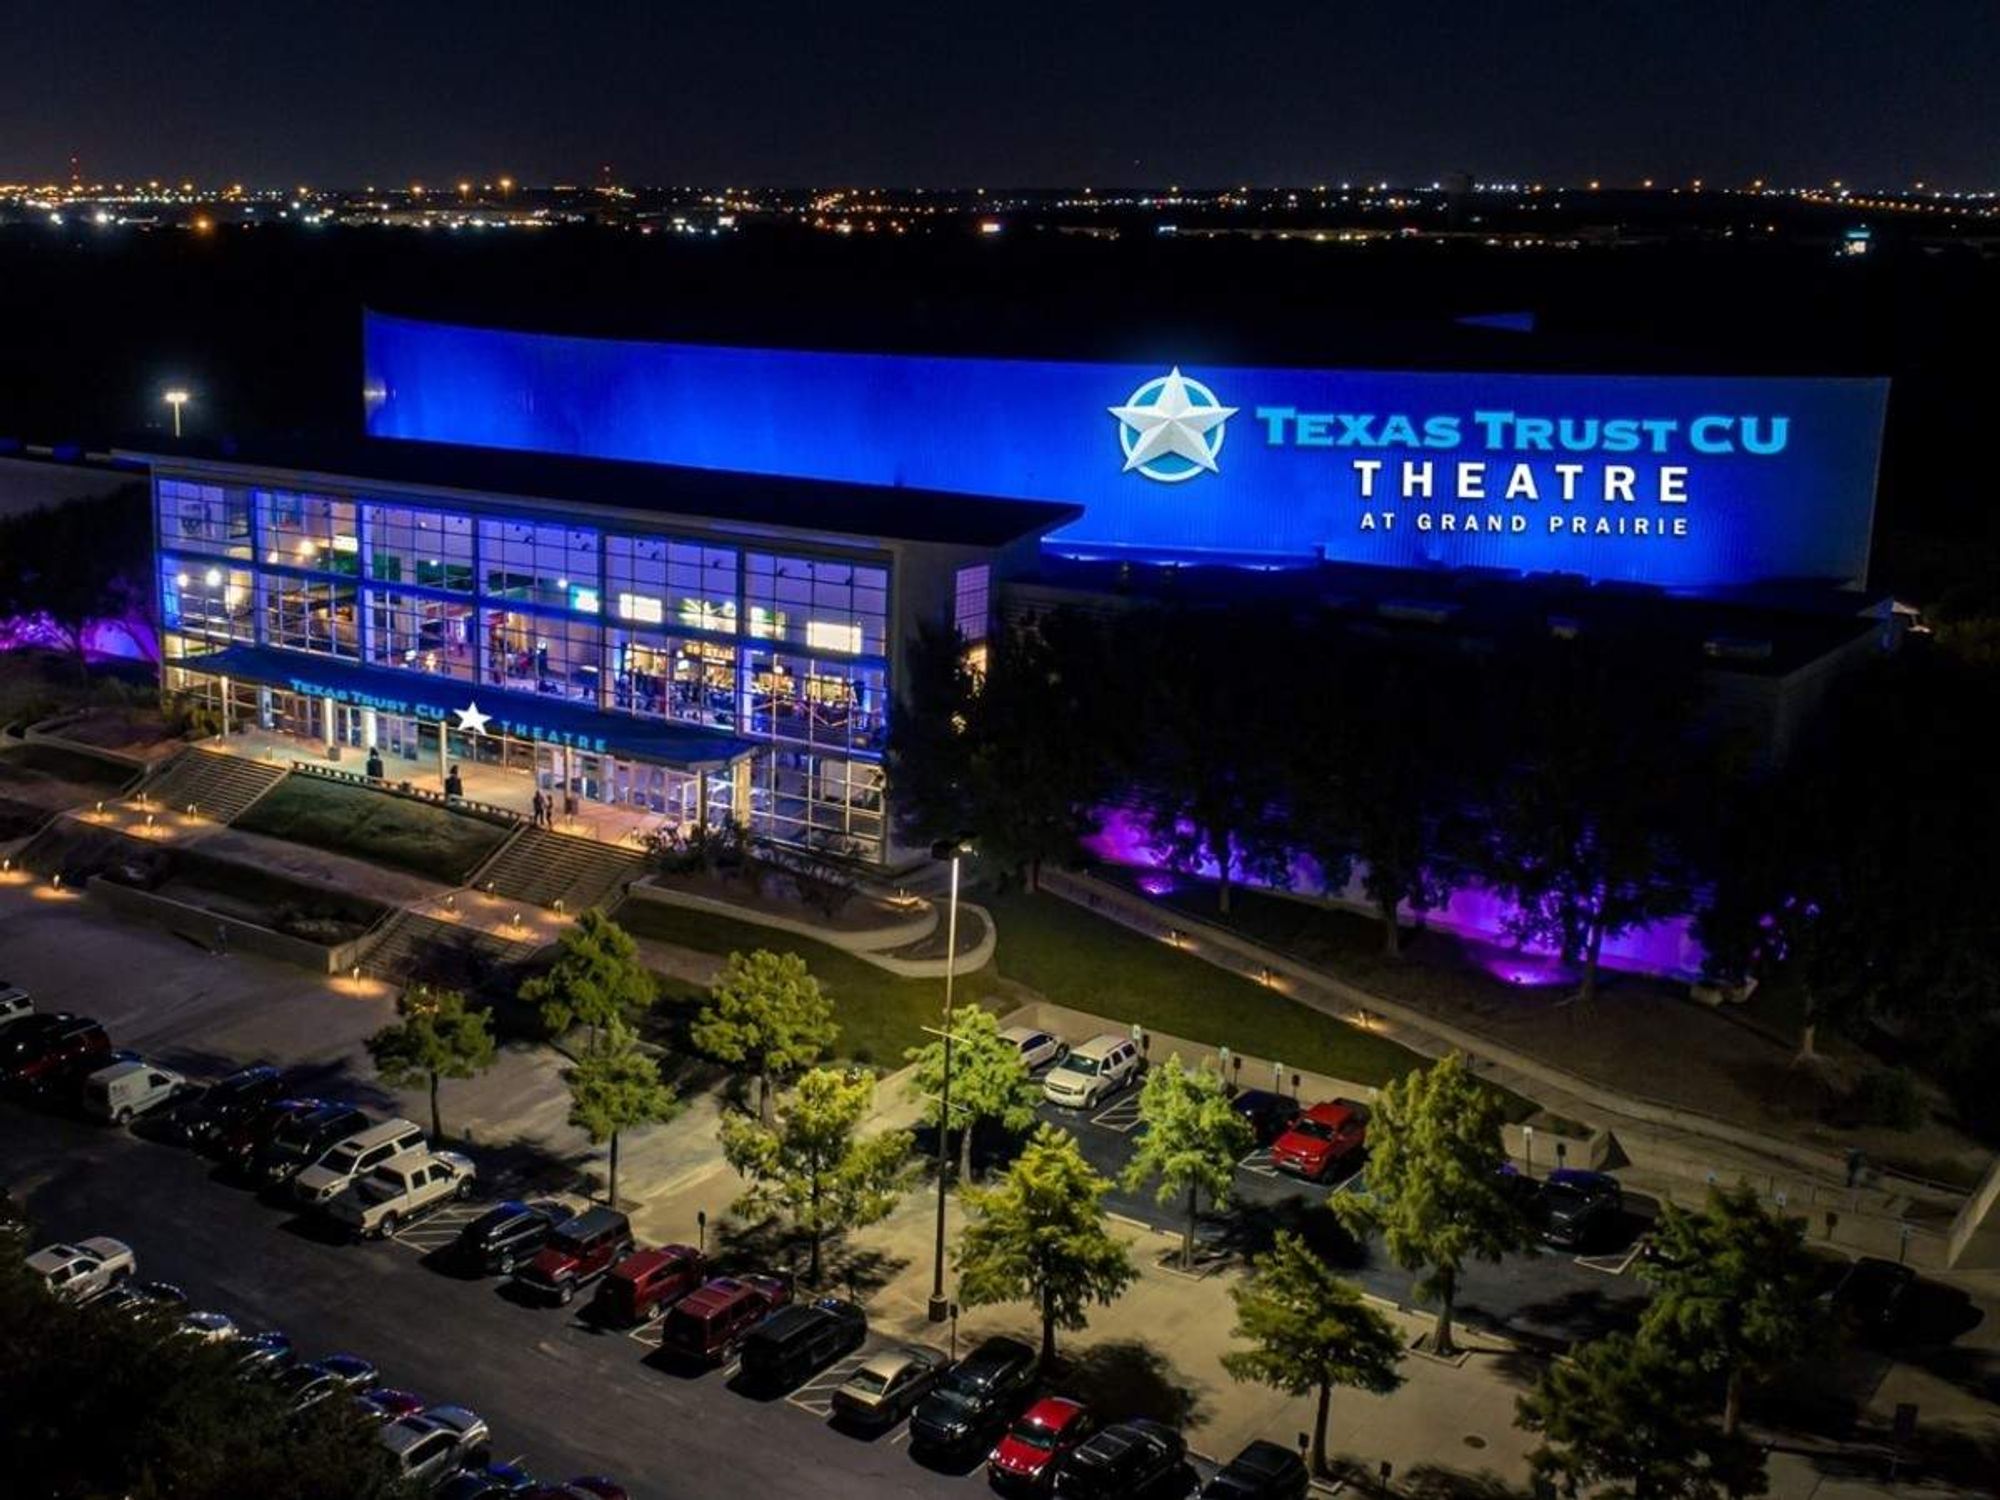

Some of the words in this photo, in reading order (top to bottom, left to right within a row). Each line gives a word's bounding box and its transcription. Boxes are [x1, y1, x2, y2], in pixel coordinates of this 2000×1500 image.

[1256, 407, 1461, 447] TEXAS
[1474, 410, 1677, 452] TRUST
[1689, 416, 1789, 454] CU
[1353, 460, 1688, 502] THEATRE
[1360, 512, 1395, 529] AT
[1417, 514, 1527, 532] GRAND
[1550, 516, 1687, 535] PRAIRIE
[290, 679, 349, 701] TEXAS
[351, 691, 409, 713] TRUST
[415, 703, 446, 720] CU
[501, 719, 607, 753] THEATRE
